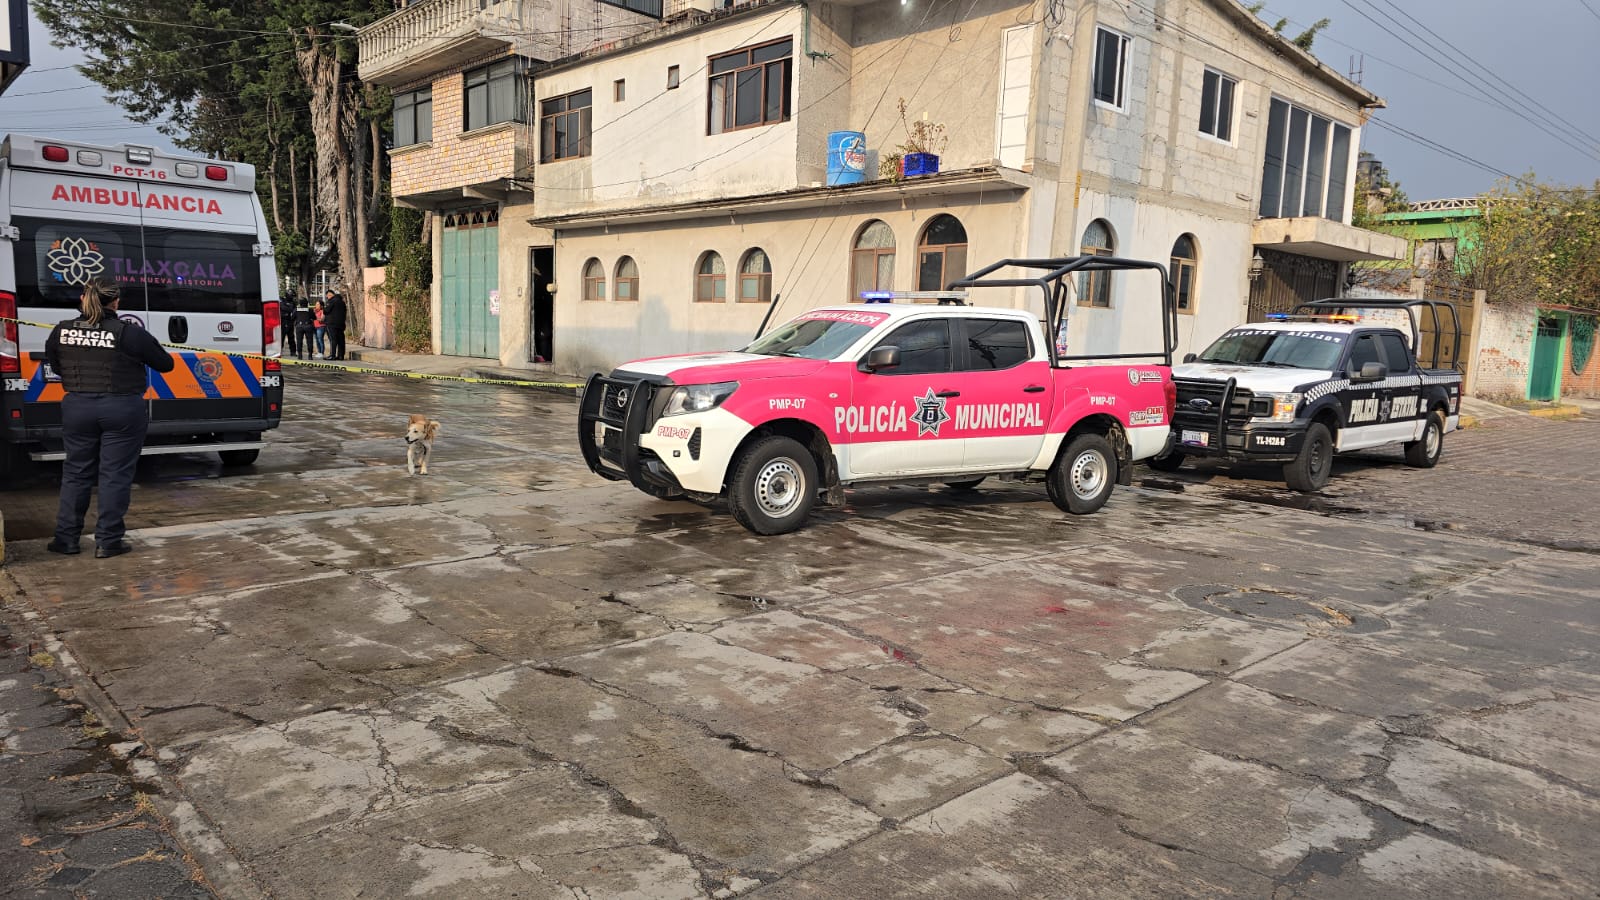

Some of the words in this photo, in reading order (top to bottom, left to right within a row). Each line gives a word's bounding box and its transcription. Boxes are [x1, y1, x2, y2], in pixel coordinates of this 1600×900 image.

[113, 165, 167, 180] PCT-16
[51, 184, 223, 215] AMBULANCIA
[110, 257, 236, 279] TLAXCALA
[115, 275, 136, 283] UNA
[140, 277, 173, 285] NUEVA
[60, 328, 115, 341] POLICÍA
[60, 336, 115, 348] ESTATAL
[769, 398, 806, 410] PMP-07
[834, 400, 907, 434] POLICÍA
[954, 402, 1044, 431] MUNICIPAL
[657, 425, 691, 440] PMP-07
